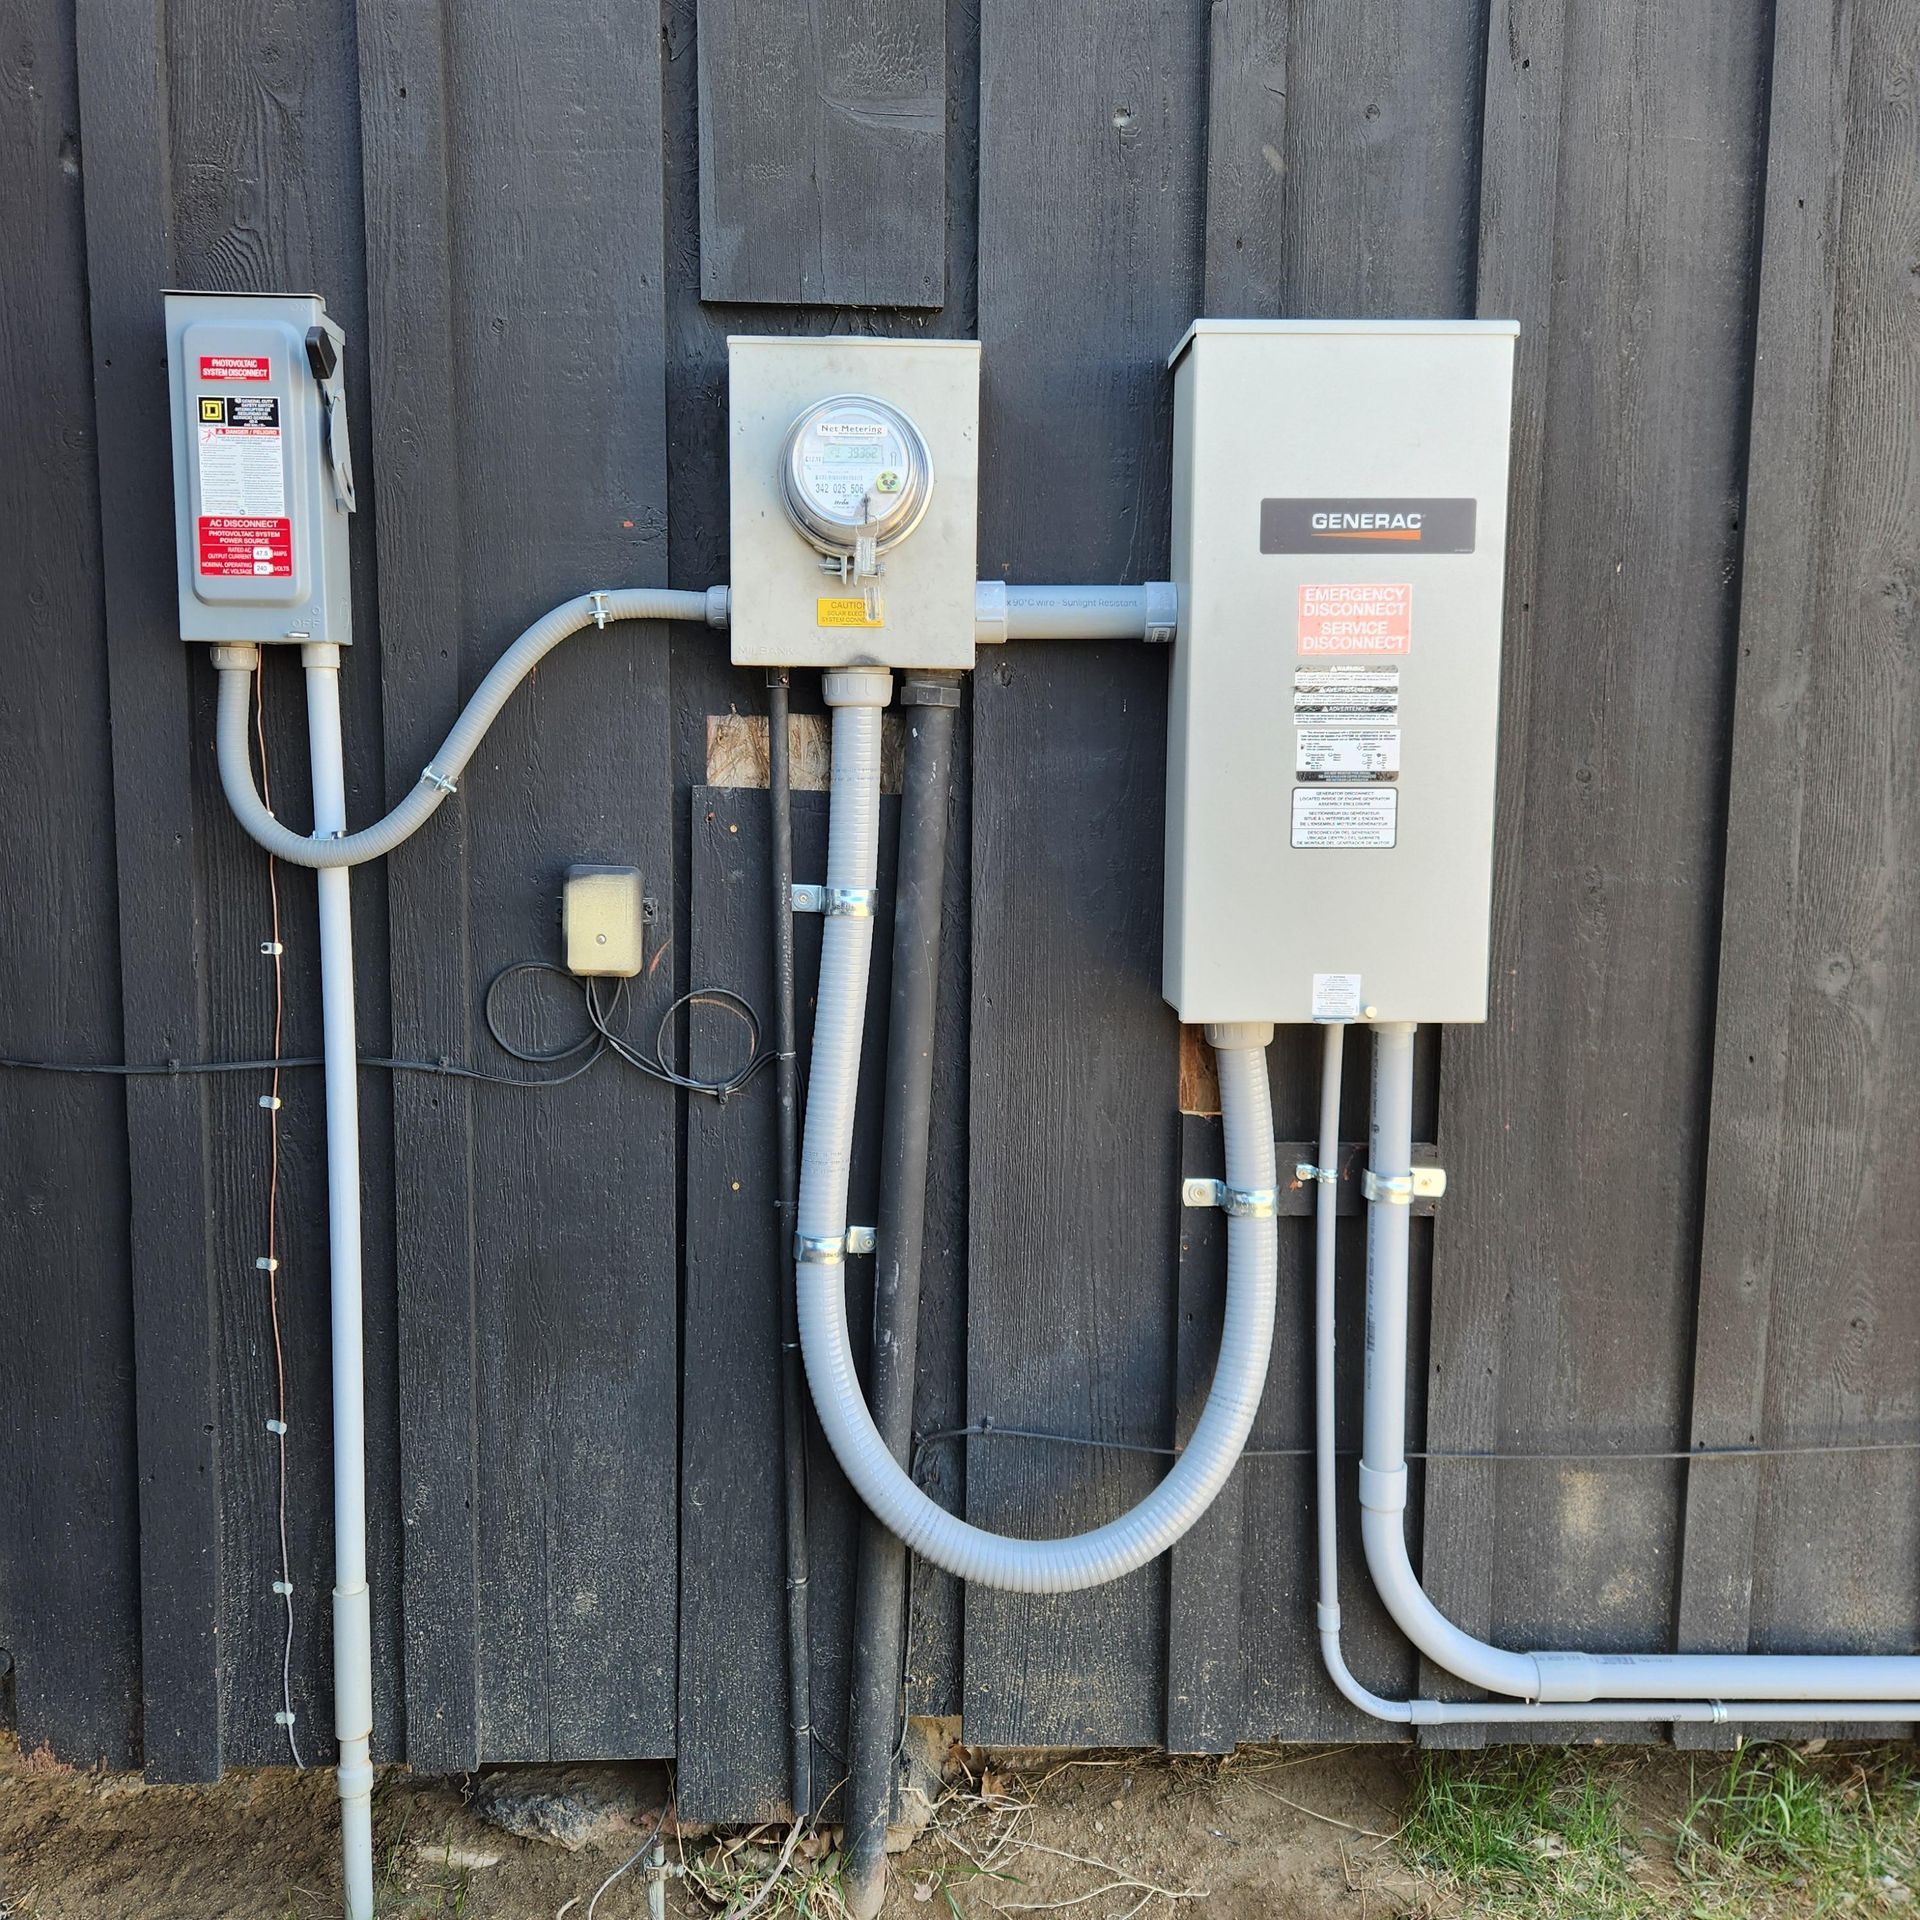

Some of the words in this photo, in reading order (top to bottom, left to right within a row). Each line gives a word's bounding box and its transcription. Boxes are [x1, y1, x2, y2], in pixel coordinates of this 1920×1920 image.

[211, 359, 257, 368] PHOTOVOLTAIC
[202, 368, 228, 376] SYSTEM
[228, 368, 267, 377] DISCONNECT
[841, 425, 882, 434] Metering
[832, 484, 846, 494] 025
[850, 484, 864, 494] 506
[209, 519, 222, 527] AC
[223, 519, 278, 528] DISCONNECT
[1312, 513, 1422, 529] GENERAC
[1305, 588, 1405, 601] EMERGENCY
[1063, 599, 1097, 608] Sunlight
[1099, 599, 1138, 607] Resistant
[1304, 602, 1406, 616] DISCONNECT
[1320, 622, 1388, 635] SERVICE
[1303, 636, 1406, 650] DISCONNECT
